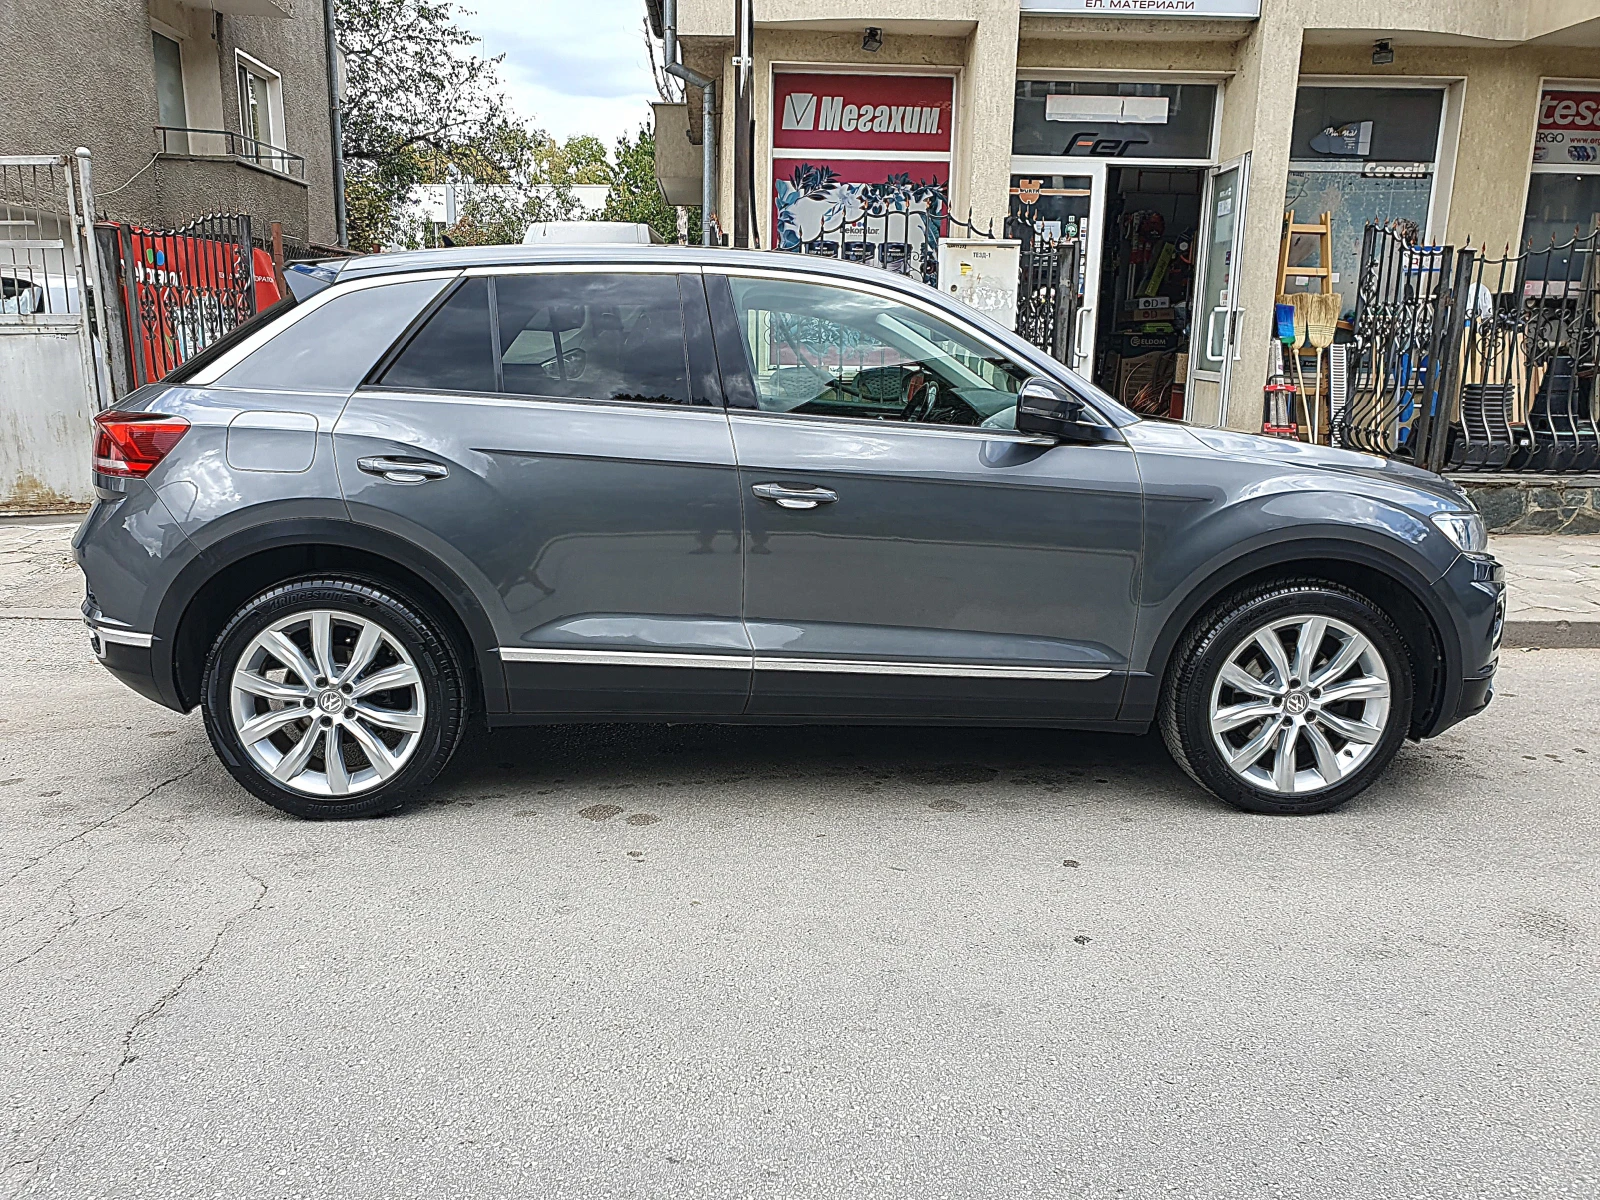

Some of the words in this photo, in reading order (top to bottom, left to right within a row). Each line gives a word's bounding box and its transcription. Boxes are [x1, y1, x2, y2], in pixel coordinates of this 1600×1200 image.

[1110, 0, 1195, 9] МАТЕРИАЛИ
[818, 96, 940, 134] Мегахим
[1364, 162, 1426, 178] Ceresit
[841, 226, 879, 235] ekortor
